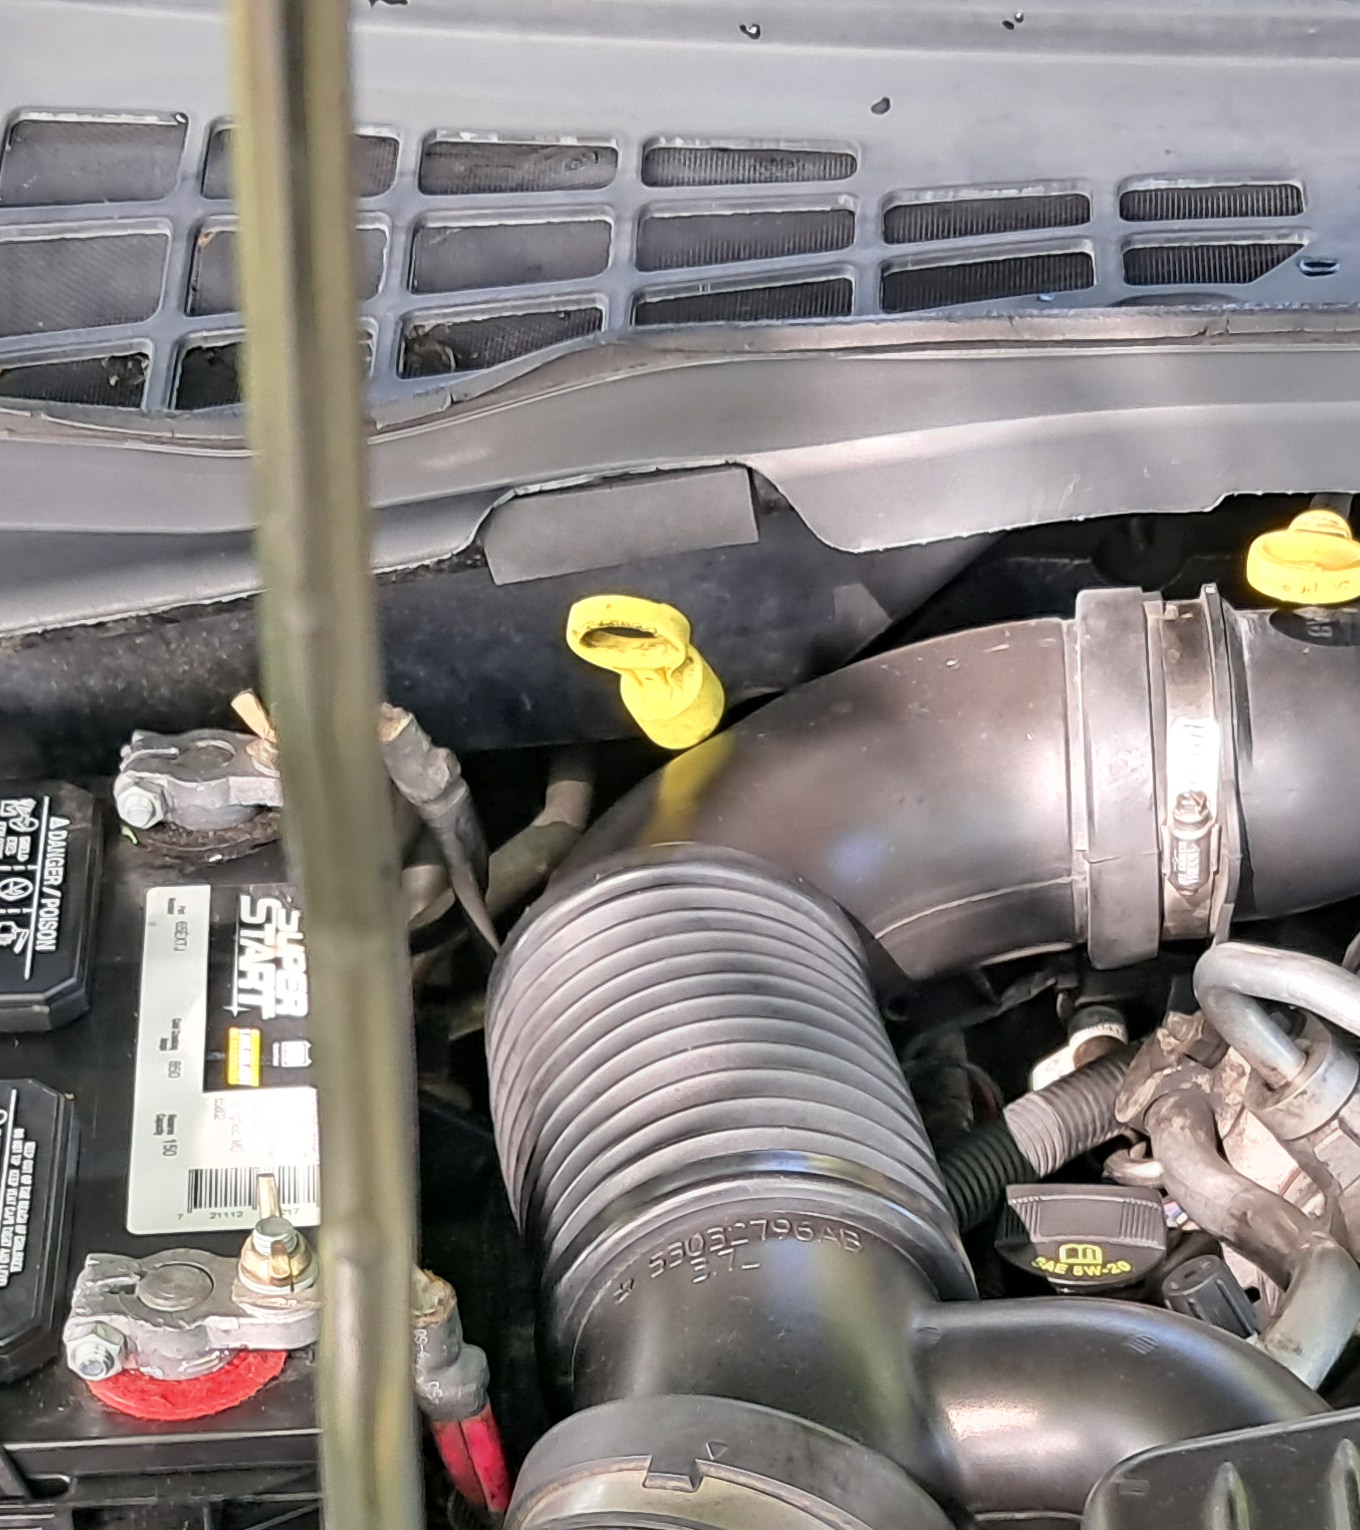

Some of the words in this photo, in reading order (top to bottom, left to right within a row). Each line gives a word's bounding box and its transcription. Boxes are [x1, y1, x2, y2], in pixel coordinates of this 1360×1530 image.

[240, 895, 282, 1020] START
[275, 906, 309, 1019] SUPER
[162, 1138, 178, 1157] 150
[1030, 1256, 1069, 1275] SAE
[1072, 1260, 1132, 1276] 5W-20
